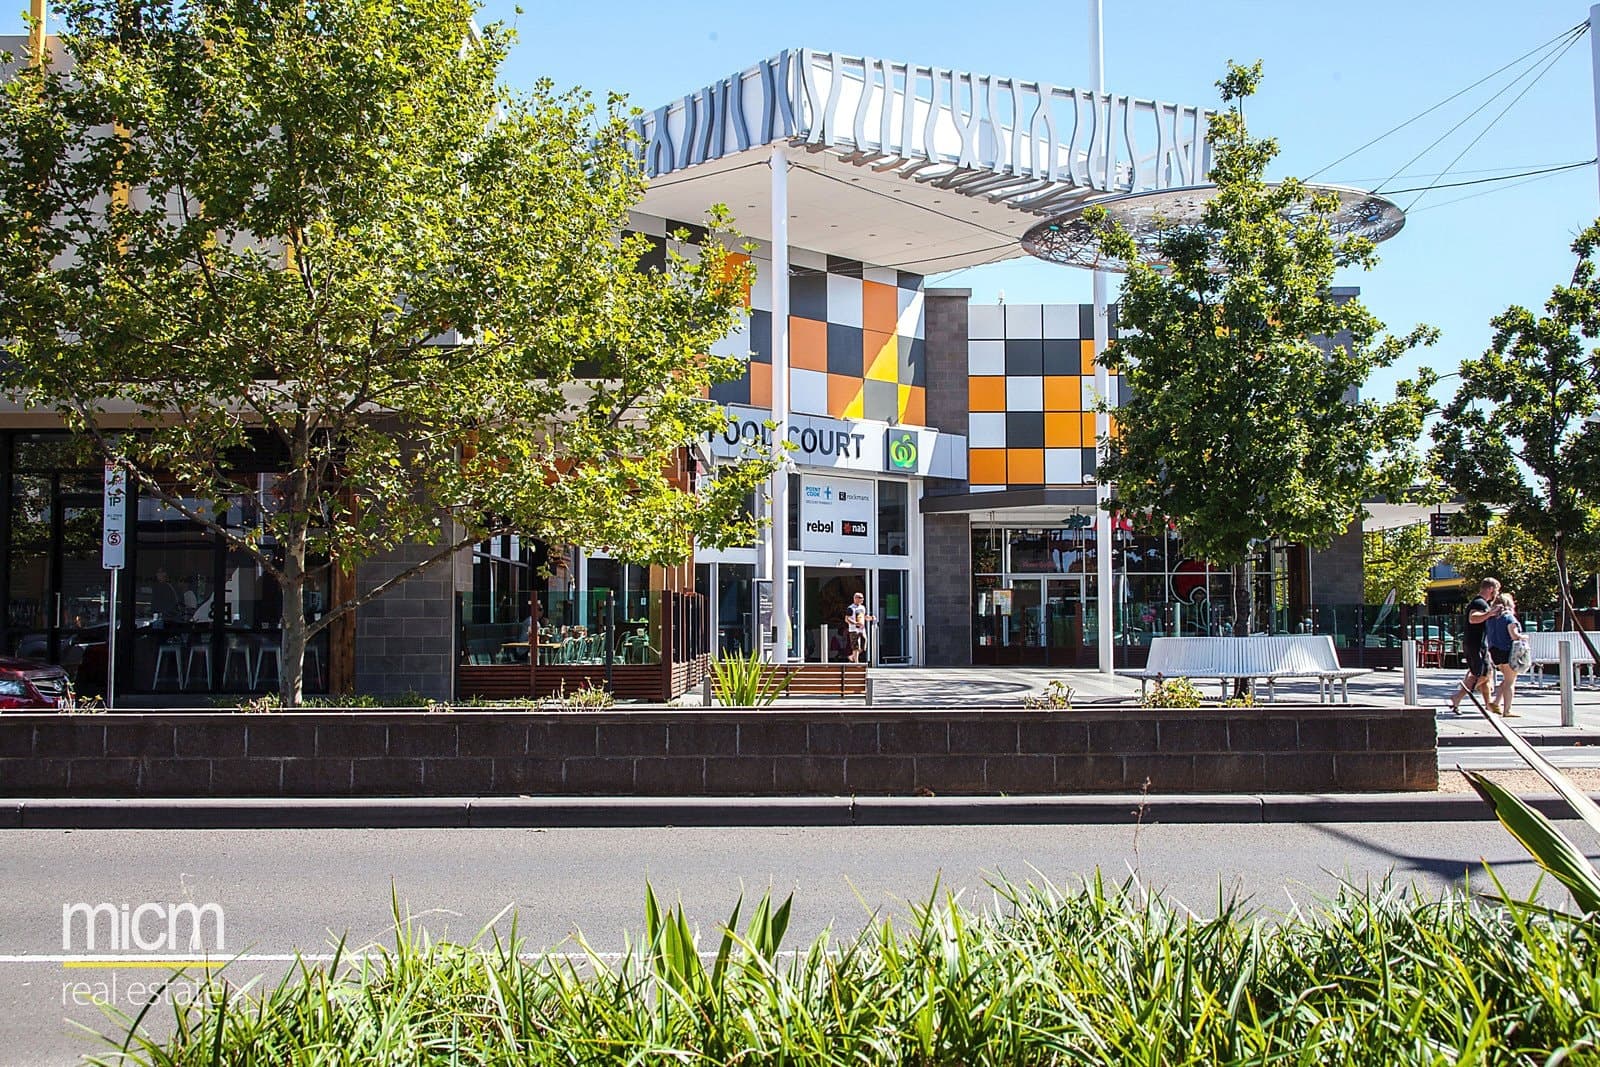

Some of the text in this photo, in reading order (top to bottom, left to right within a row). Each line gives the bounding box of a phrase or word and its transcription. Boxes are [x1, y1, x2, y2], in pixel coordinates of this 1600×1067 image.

[788, 425, 865, 460] COURT
[806, 519, 834, 534] rebel
[852, 523, 866, 533] nab
